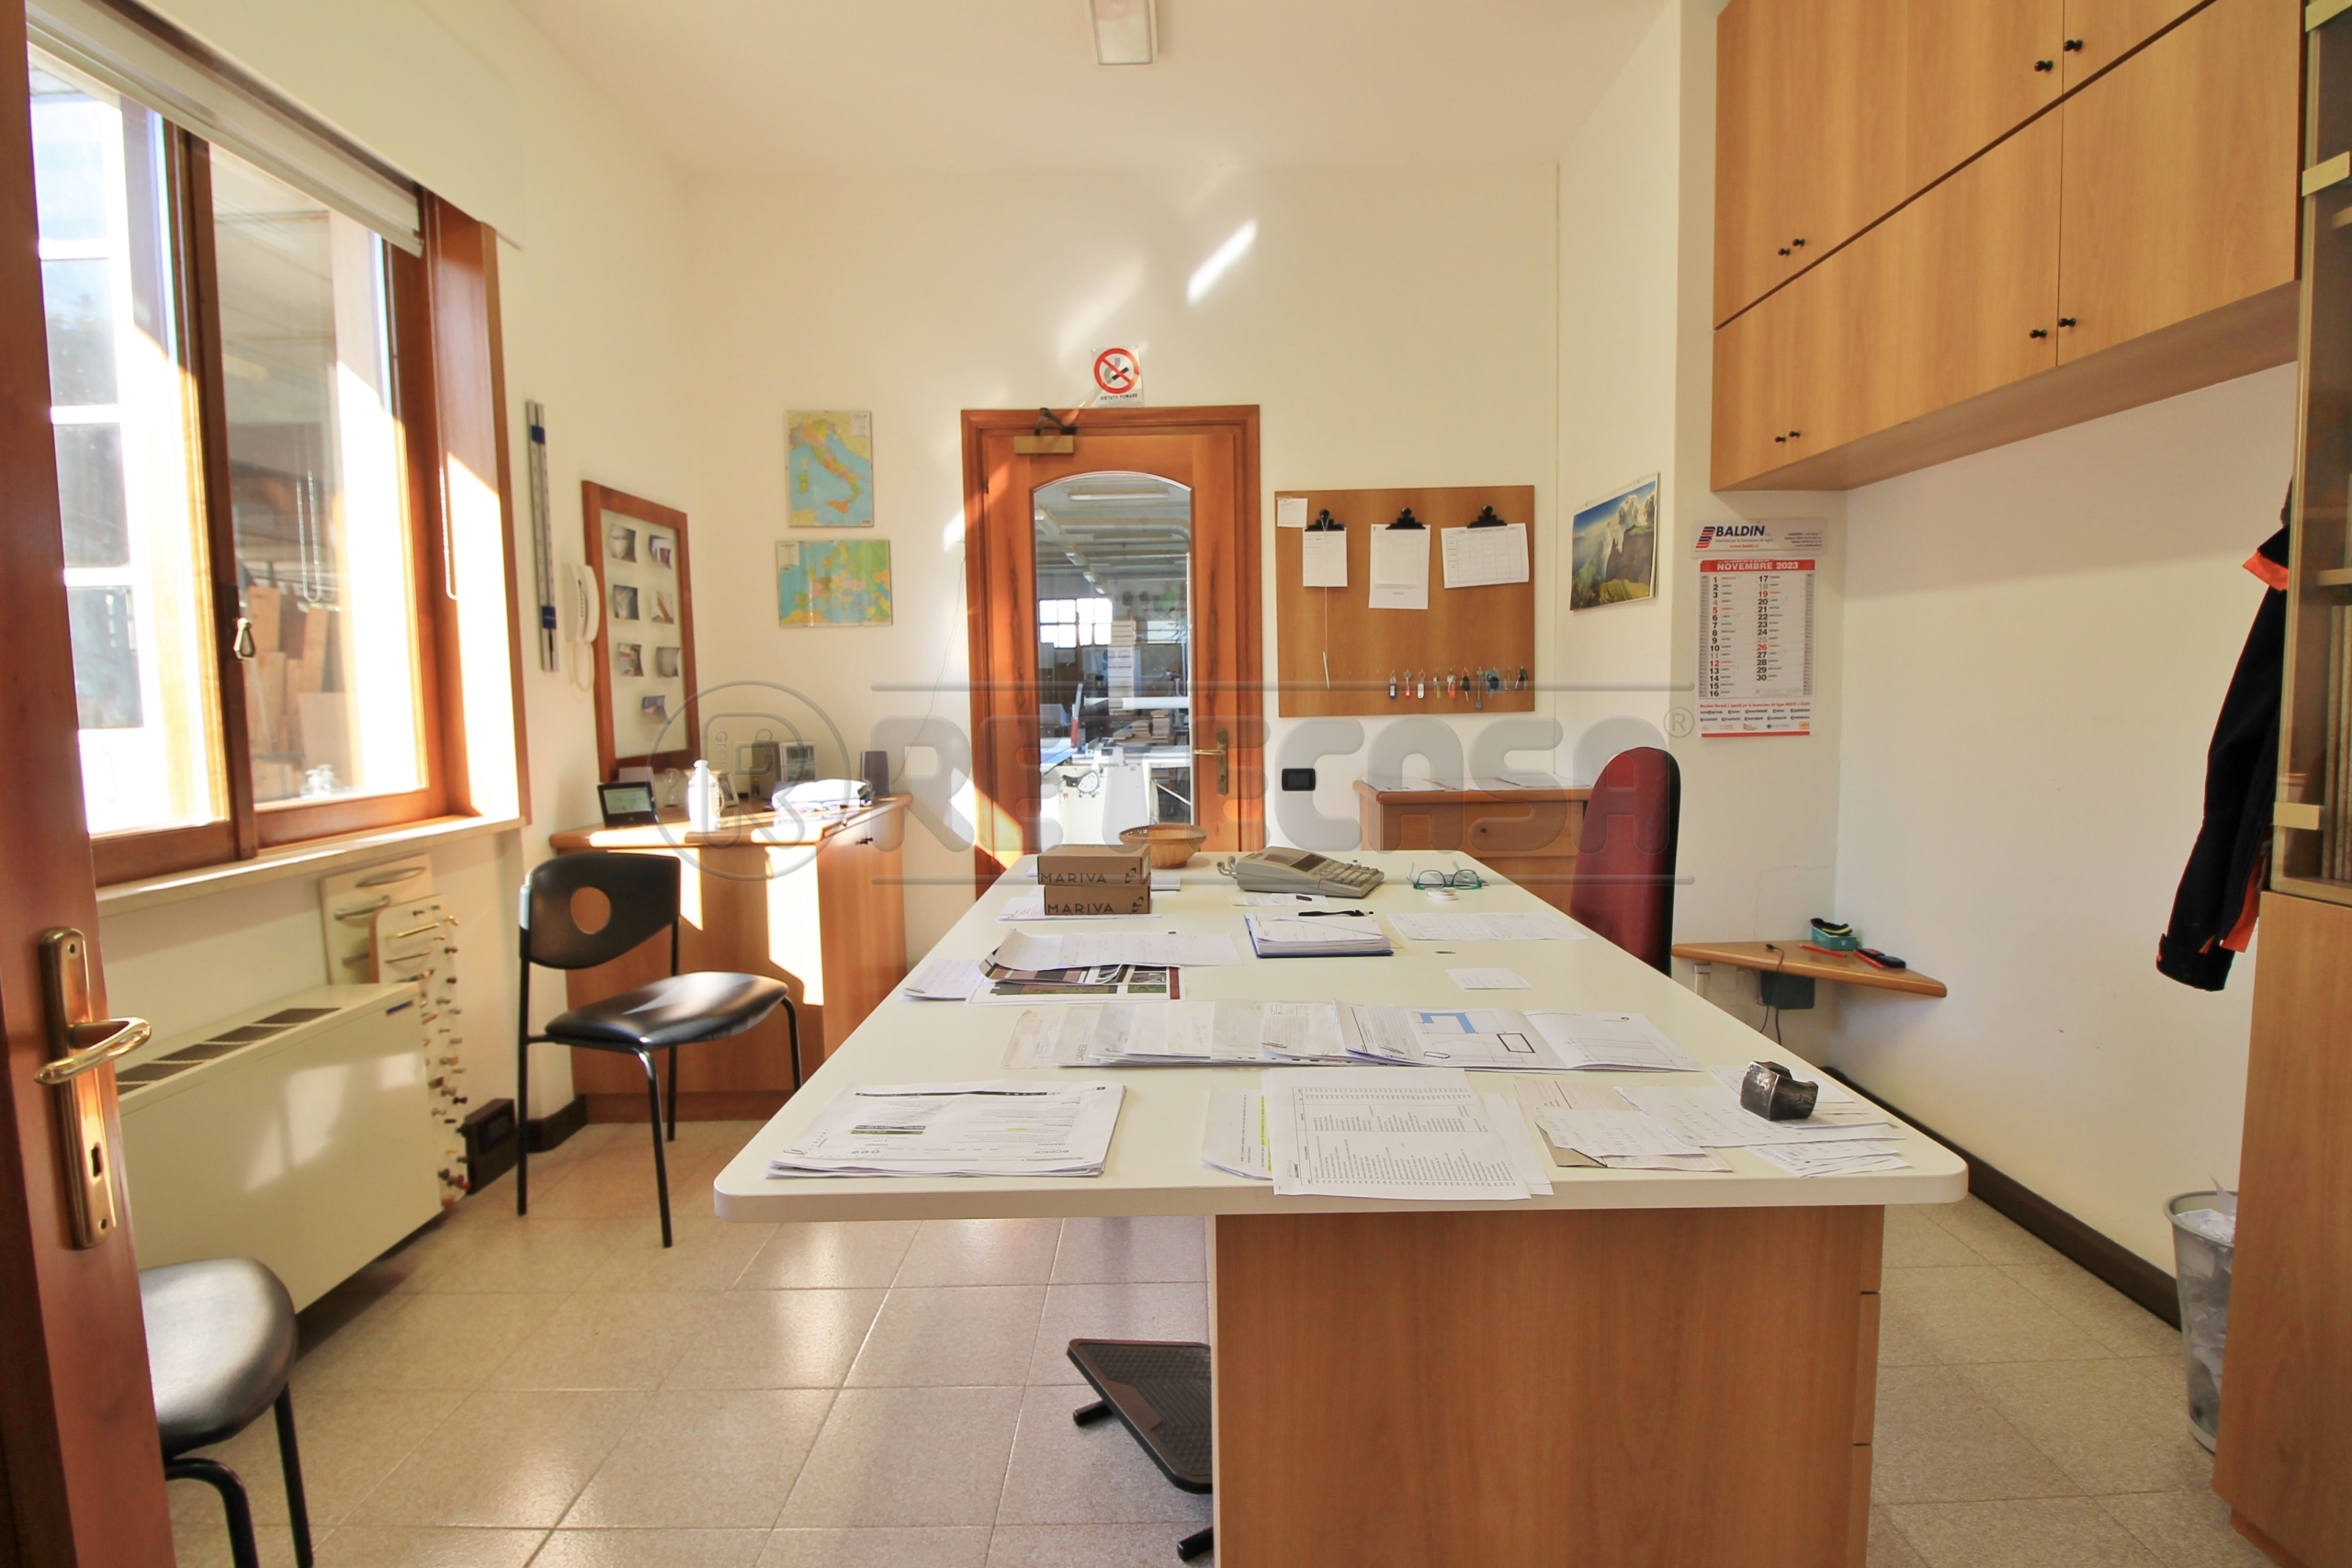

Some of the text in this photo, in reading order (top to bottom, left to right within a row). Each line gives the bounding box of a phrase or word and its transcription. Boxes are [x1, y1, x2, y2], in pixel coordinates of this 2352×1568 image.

[1715, 525, 1766, 537] BALDIN
[1716, 561, 1799, 570] NOVEMBRE 2023
[1041, 873, 1107, 884] MARIVA
[1047, 903, 1114, 914] MARIVA
